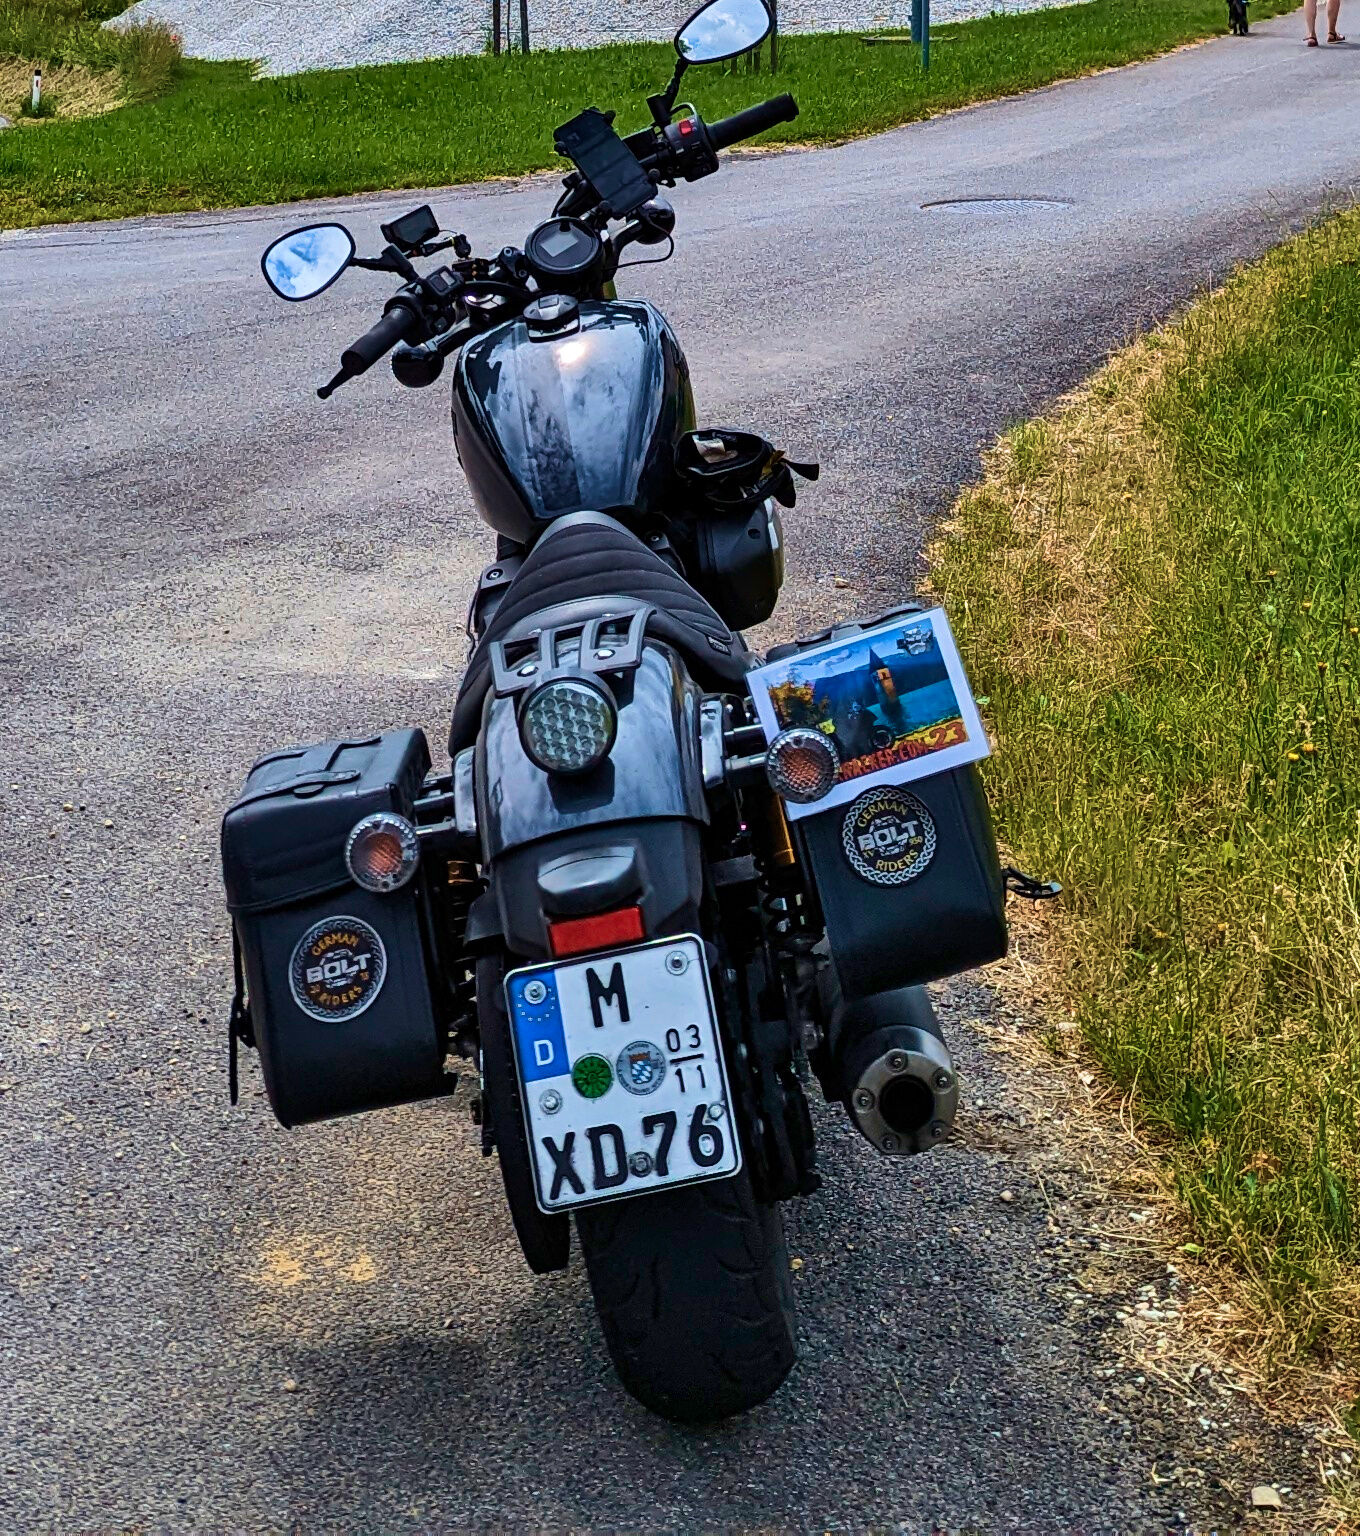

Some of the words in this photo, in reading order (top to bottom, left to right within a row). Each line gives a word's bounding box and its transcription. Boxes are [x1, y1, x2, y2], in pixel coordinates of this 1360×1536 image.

[929, 721, 968, 750] 23
[857, 800, 909, 827] GERMAN
[857, 820, 918, 851] BOLT
[875, 849, 919, 871] RIDERS
[306, 953, 372, 984] BOLT
[585, 962, 630, 1028] M
[533, 1039, 555, 1066] D
[665, 1024, 701, 1052] 03
[674, 1064, 706, 1093] 11
